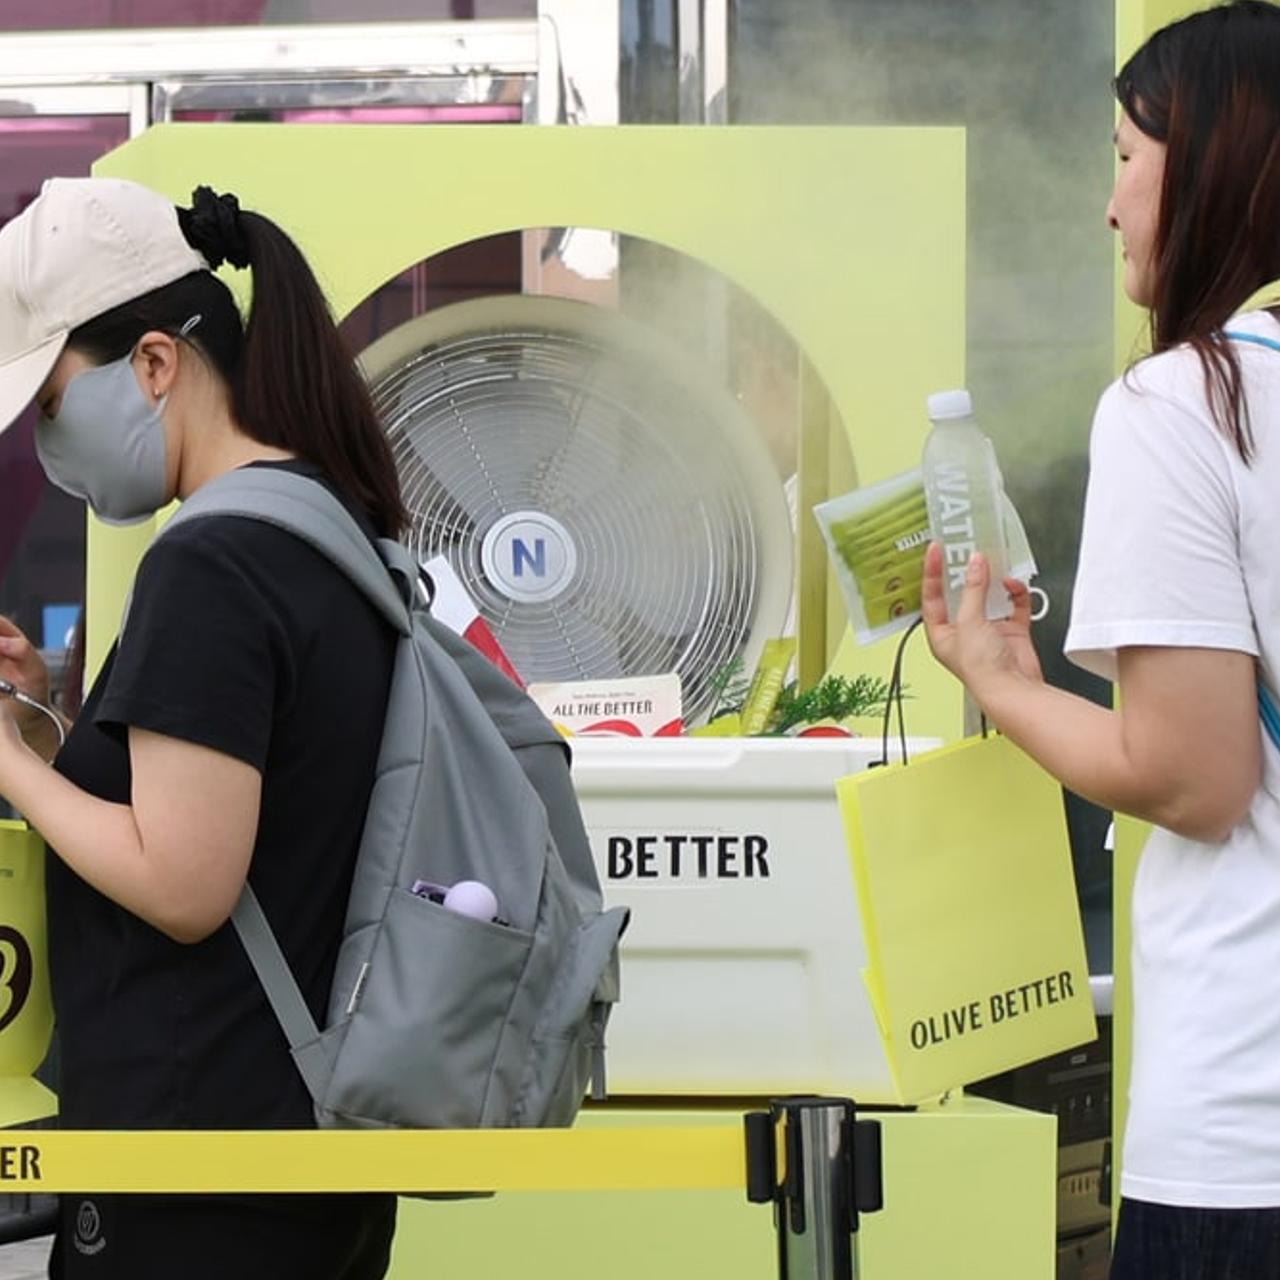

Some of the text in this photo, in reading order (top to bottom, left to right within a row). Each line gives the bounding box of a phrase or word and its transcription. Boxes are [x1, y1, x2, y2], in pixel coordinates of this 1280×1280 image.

[512, 538, 546, 578] N
[553, 699, 653, 717] ALL THE BETTER
[607, 834, 770, 879] BETTER
[910, 970, 1075, 1050] OLIVE BETTER
